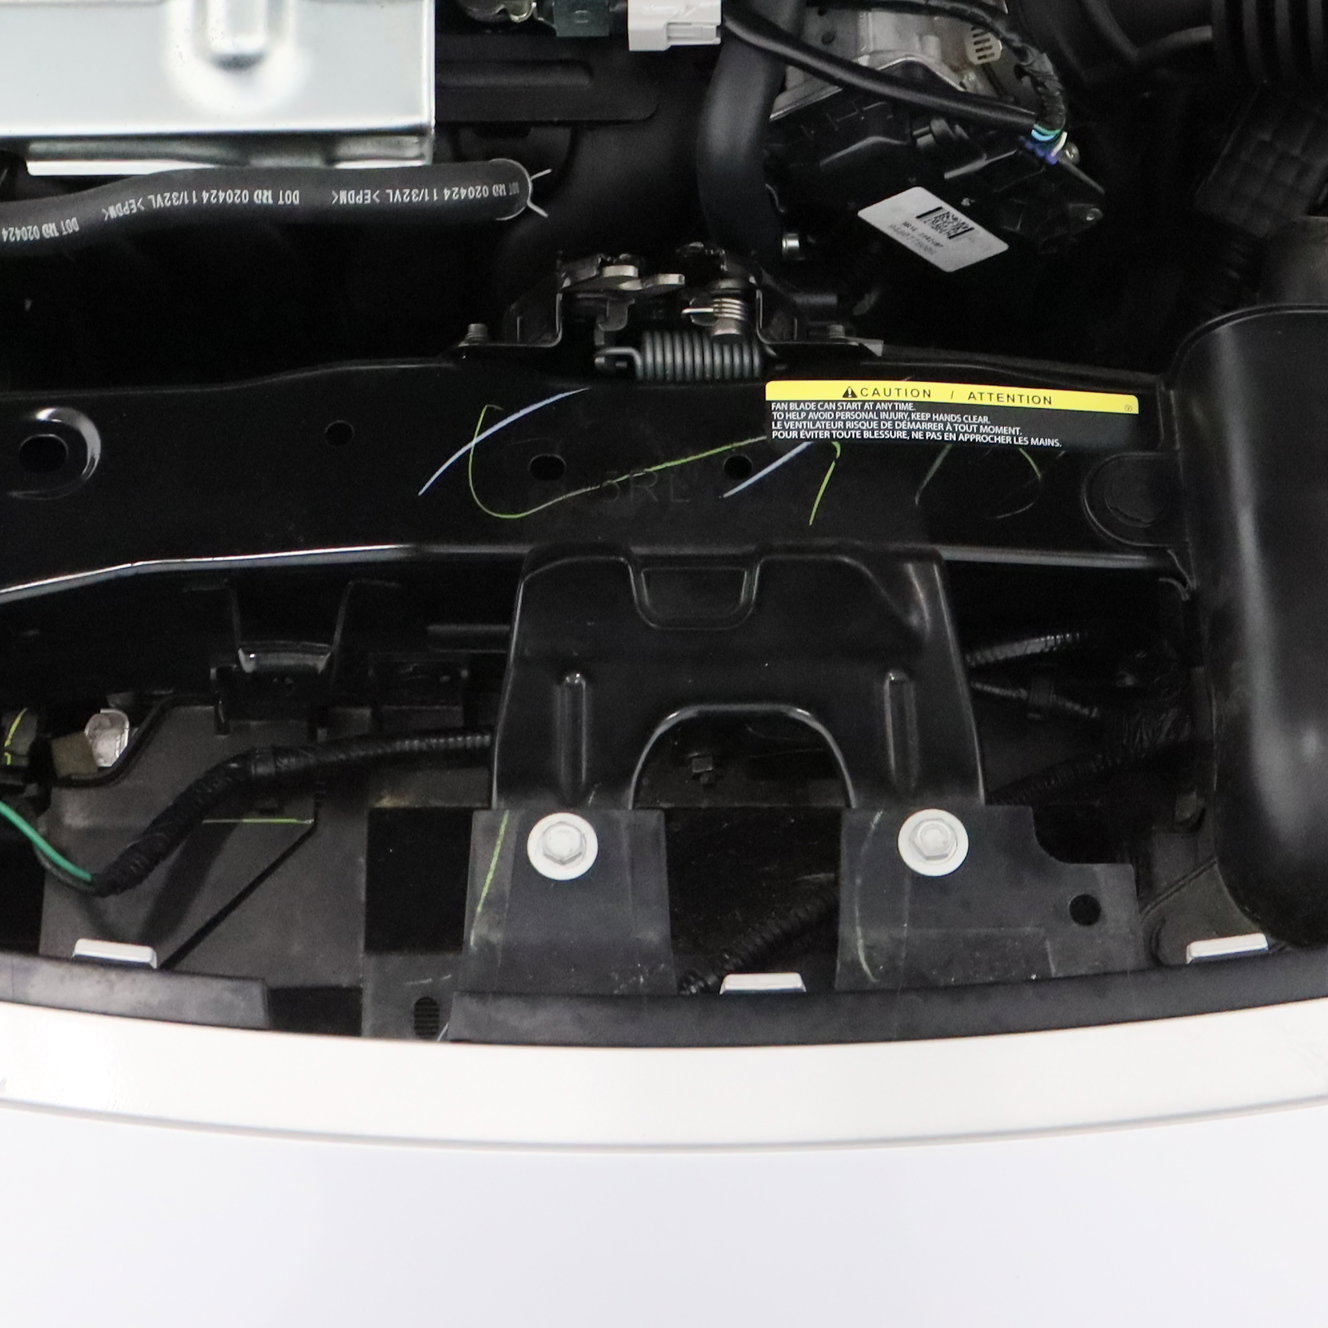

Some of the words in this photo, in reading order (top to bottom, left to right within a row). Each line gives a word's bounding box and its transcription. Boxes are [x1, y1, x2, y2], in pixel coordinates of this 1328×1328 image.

[202, 188, 250, 205] 020424
[277, 189, 301, 205] DOT
[331, 188, 381, 205] >EPDM<
[443, 183, 490, 201] 020424
[101, 195, 144, 222] >EPDM<
[1, 224, 40, 243] 020424
[59, 216, 80, 235] DOT
[860, 387, 932, 398] CAUTION
[967, 391, 1052, 405] ATTENTION
[772, 402, 788, 410] FAN
[789, 402, 816, 410] BLADE
[818, 403, 836, 411] CAN
[837, 403, 862, 411] START
[863, 403, 874, 411] AT
[876, 403, 892, 411] ANY
[893, 403, 916, 411] TIME.
[772, 412, 784, 420] TO
[785, 412, 807, 420] HELP
[808, 412, 834, 420] AVOID
[835, 412, 879, 420] PERSONAL
[880, 413, 910, 422] INJURY,
[932, 414, 961, 422] HANDS
[963, 415, 990, 424] CLEAR.
[772, 421, 782, 429] LE
[784, 421, 844, 430] VENTILATEUR
[845, 421, 878, 430] RISQUE
[880, 422, 893, 430] DE
[895, 420, 944, 431] DÉMARRER
[946, 422, 952, 431] À
[955, 424, 978, 432] TOUT
[979, 426, 1022, 435] MOMENT.
[772, 430, 798, 439] POUR
[800, 429, 831, 439] ÉVITER
[832, 431, 862, 439] TOUTE
[863, 431, 910, 440] BLESSURE,
[912, 432, 924, 440] NE
[927, 433, 942, 441] PAS
[944, 433, 956, 441] EN
[958, 433, 1012, 444] APPROCHER
[1013, 436, 1028, 445] LES
[1030, 438, 1062, 447] MAINS.
